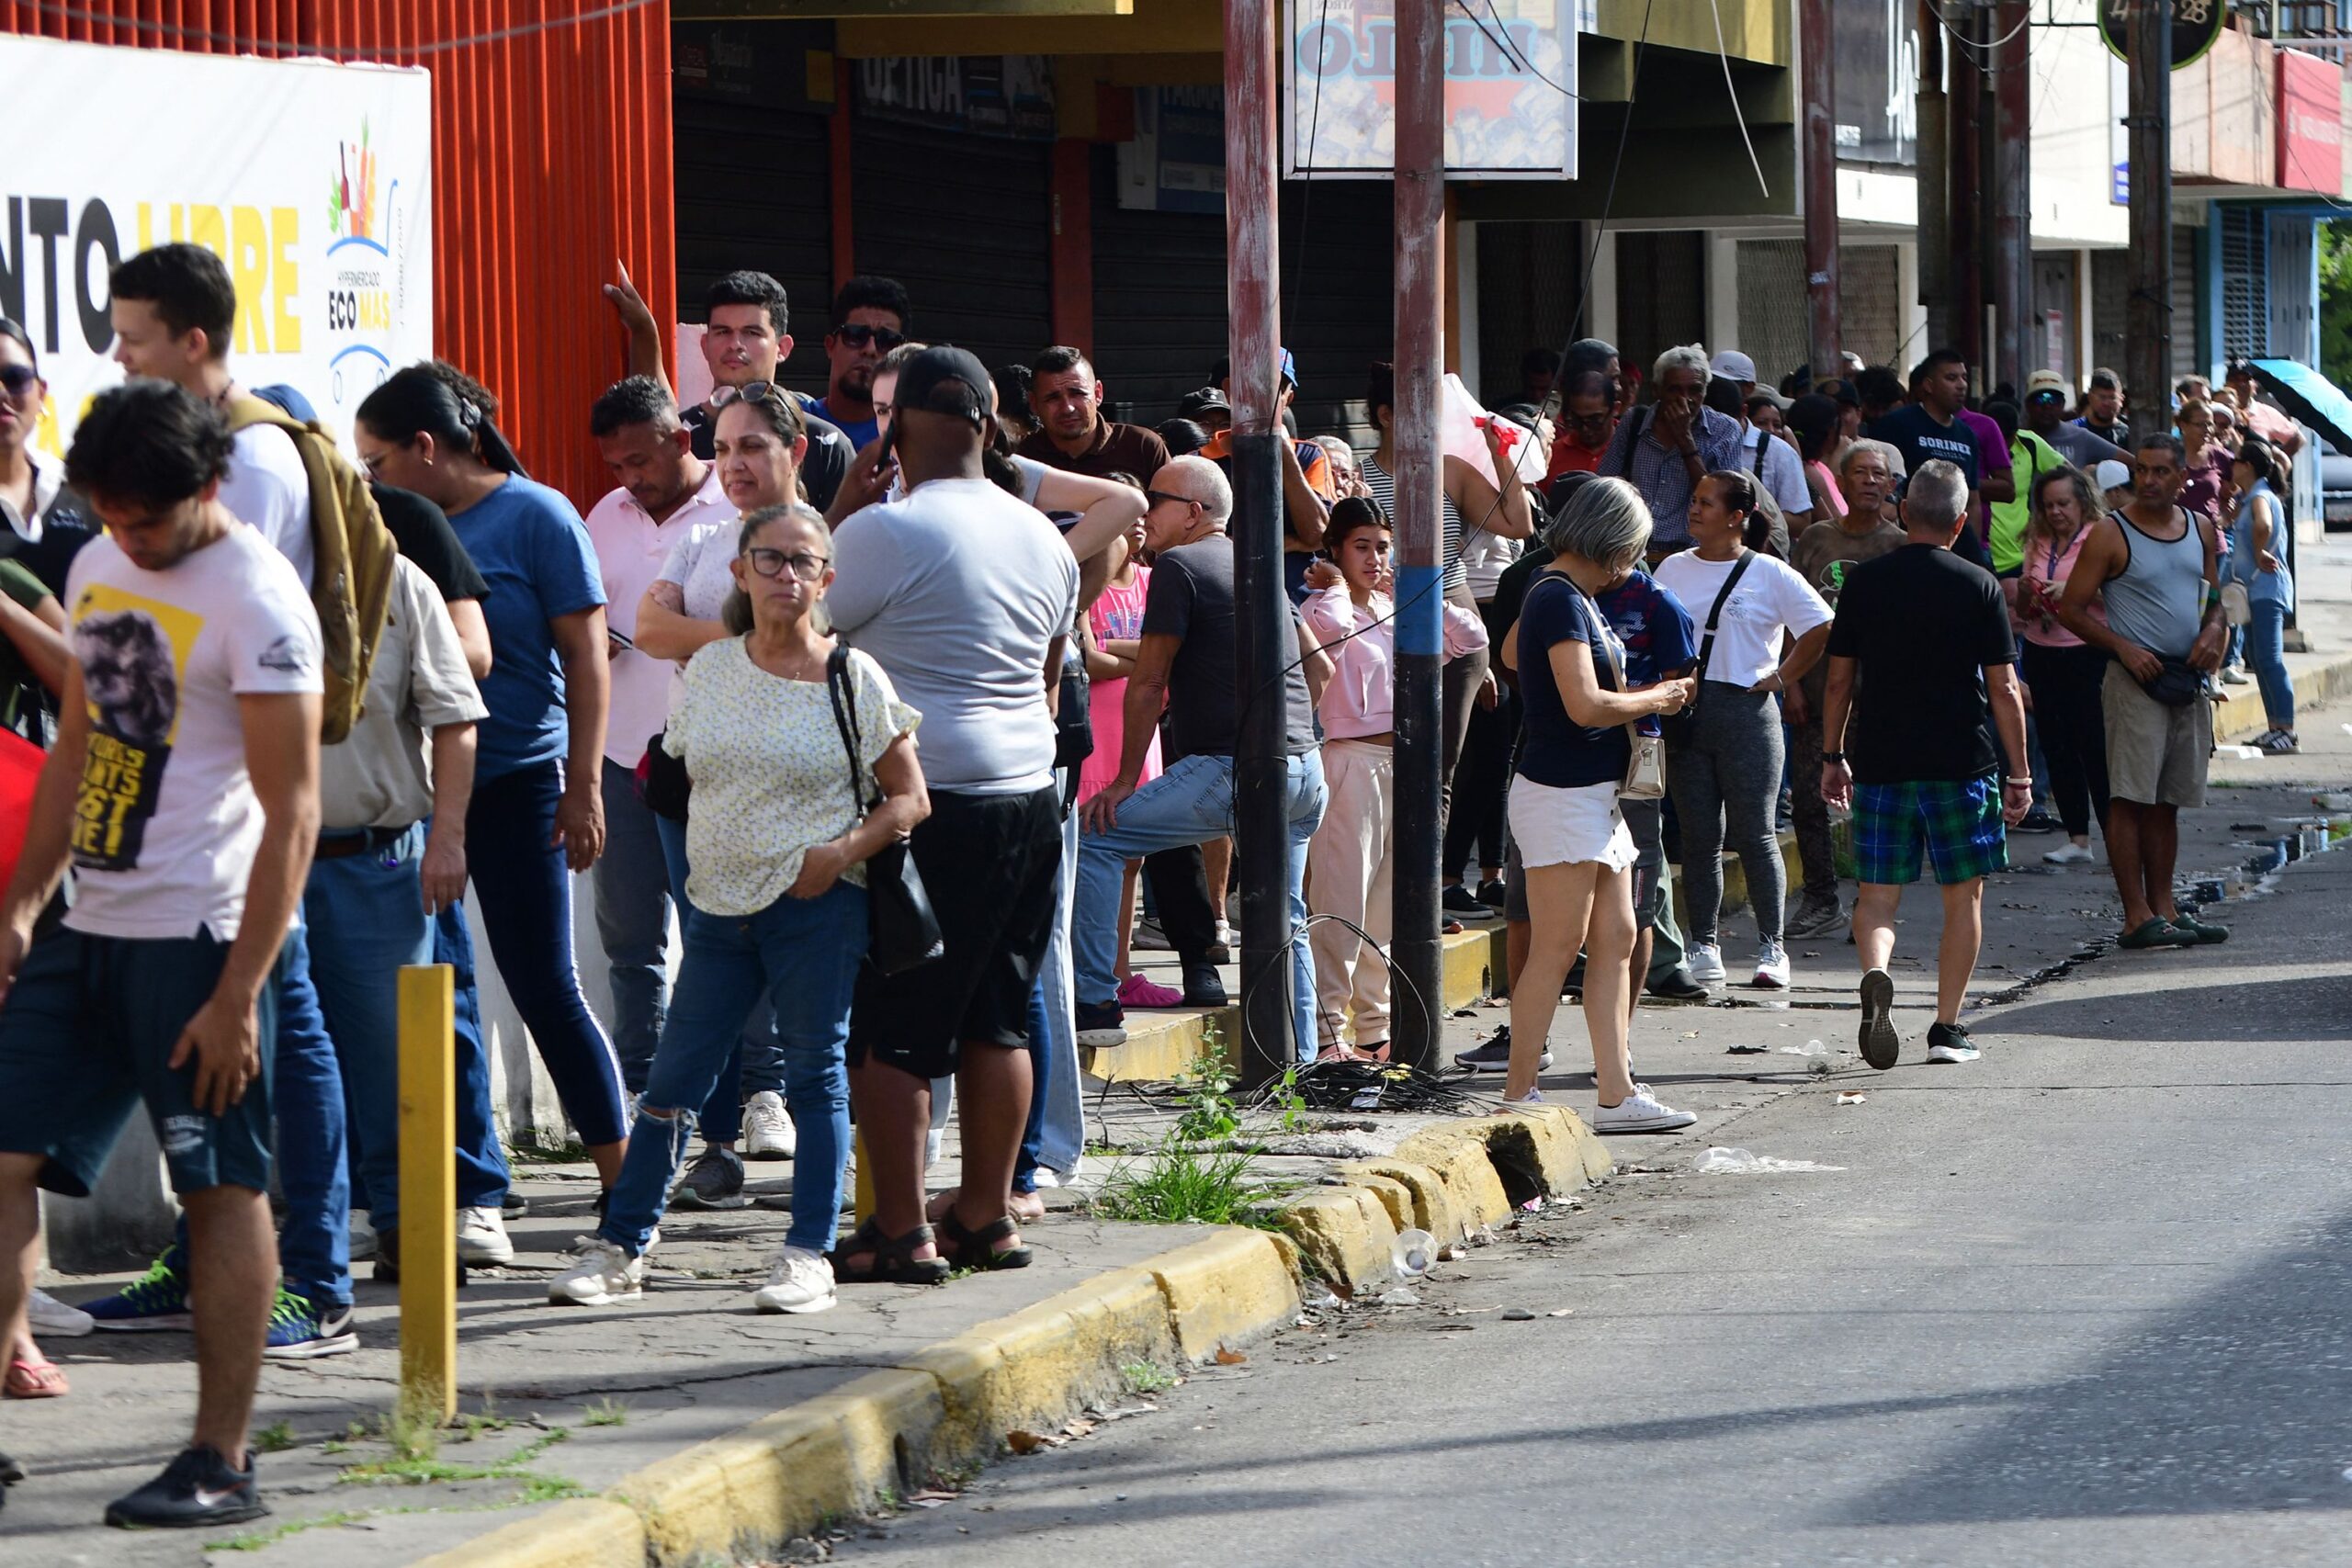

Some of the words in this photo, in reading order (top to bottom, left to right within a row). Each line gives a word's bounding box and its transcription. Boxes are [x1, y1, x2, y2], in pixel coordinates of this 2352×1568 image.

[329, 290, 356, 330] ECO
[359, 290, 390, 330] MAS
[1918, 435, 1971, 456] SORINEX
